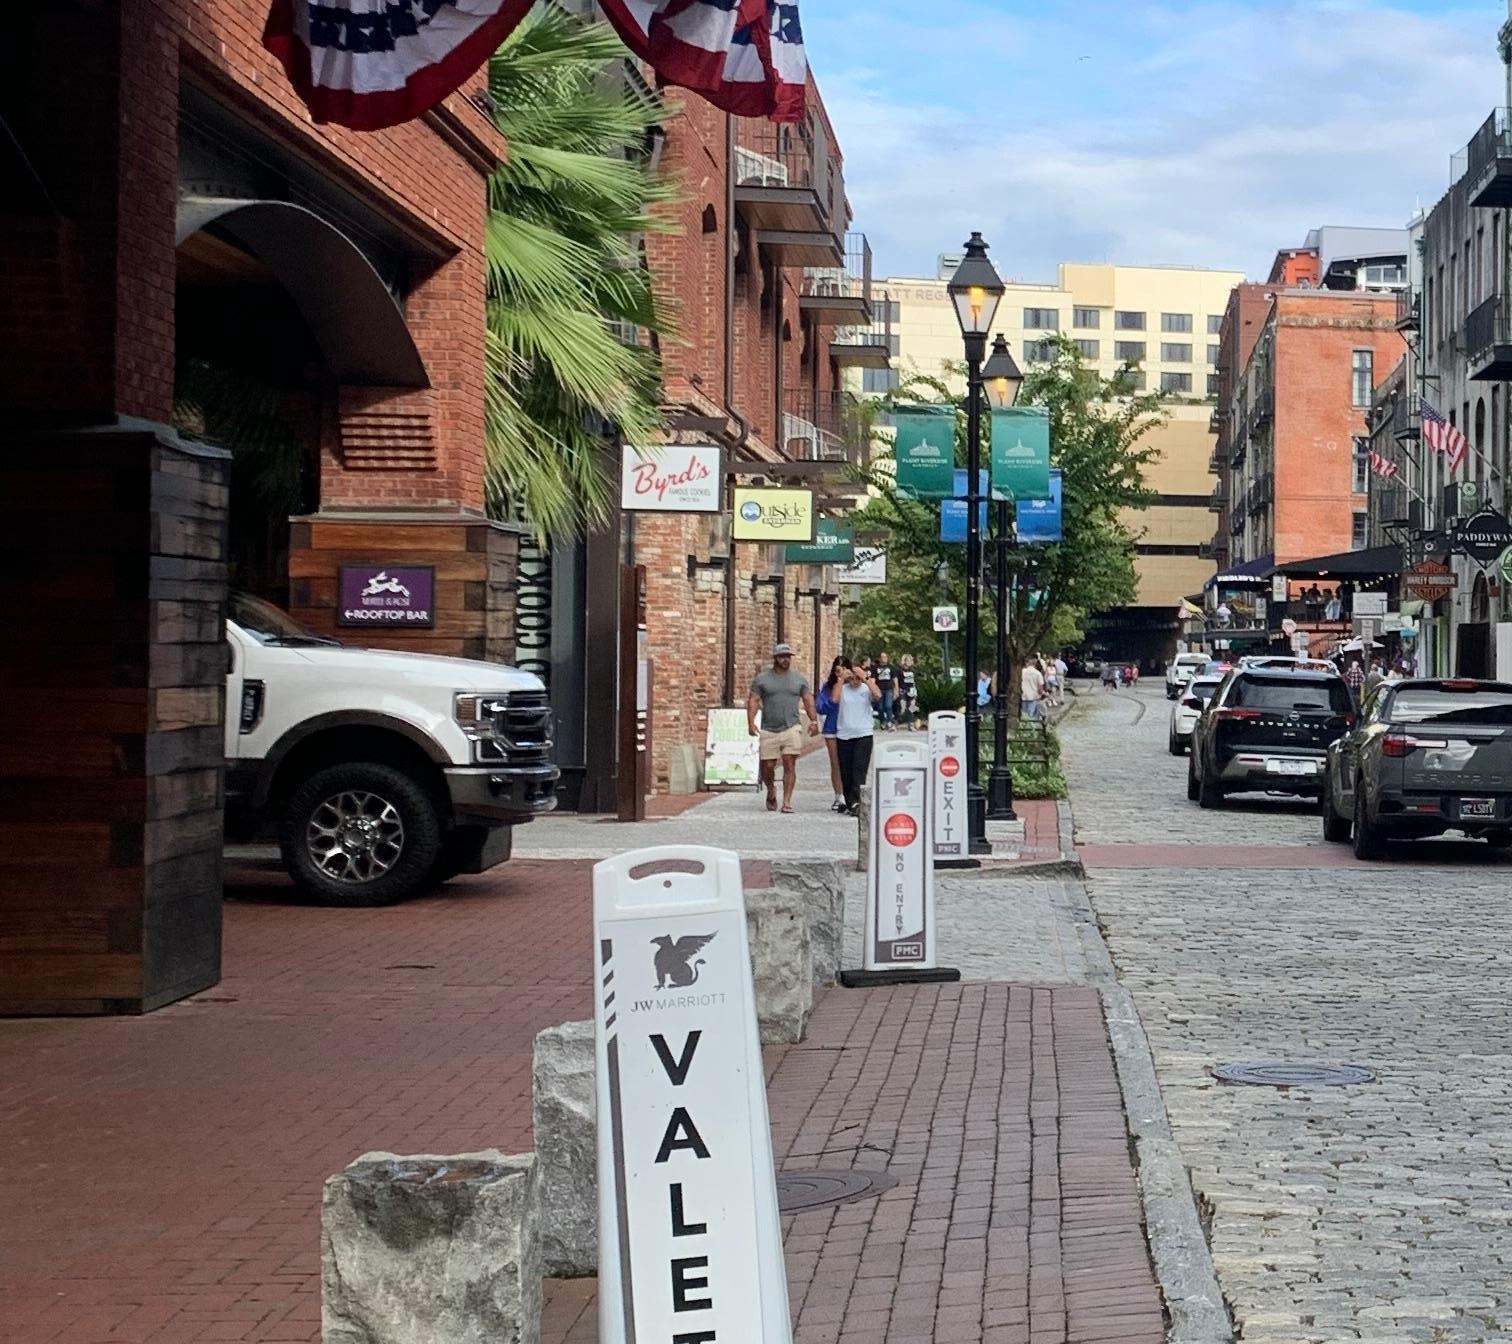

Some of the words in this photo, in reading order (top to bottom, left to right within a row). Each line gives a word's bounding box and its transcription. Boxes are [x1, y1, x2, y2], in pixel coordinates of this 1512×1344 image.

[631, 455, 711, 502] Byrd's
[353, 609, 405, 619] ROOFTOP
[407, 610, 429, 620] BAR
[943, 781, 954, 841] EXIT
[938, 845, 958, 853] PMC
[895, 852, 904, 872] NO
[894, 883, 904, 936] ENTRY
[896, 946, 918, 956] PMC
[631, 999, 654, 1013] JW
[655, 993, 727, 1010] MARRIOTT
